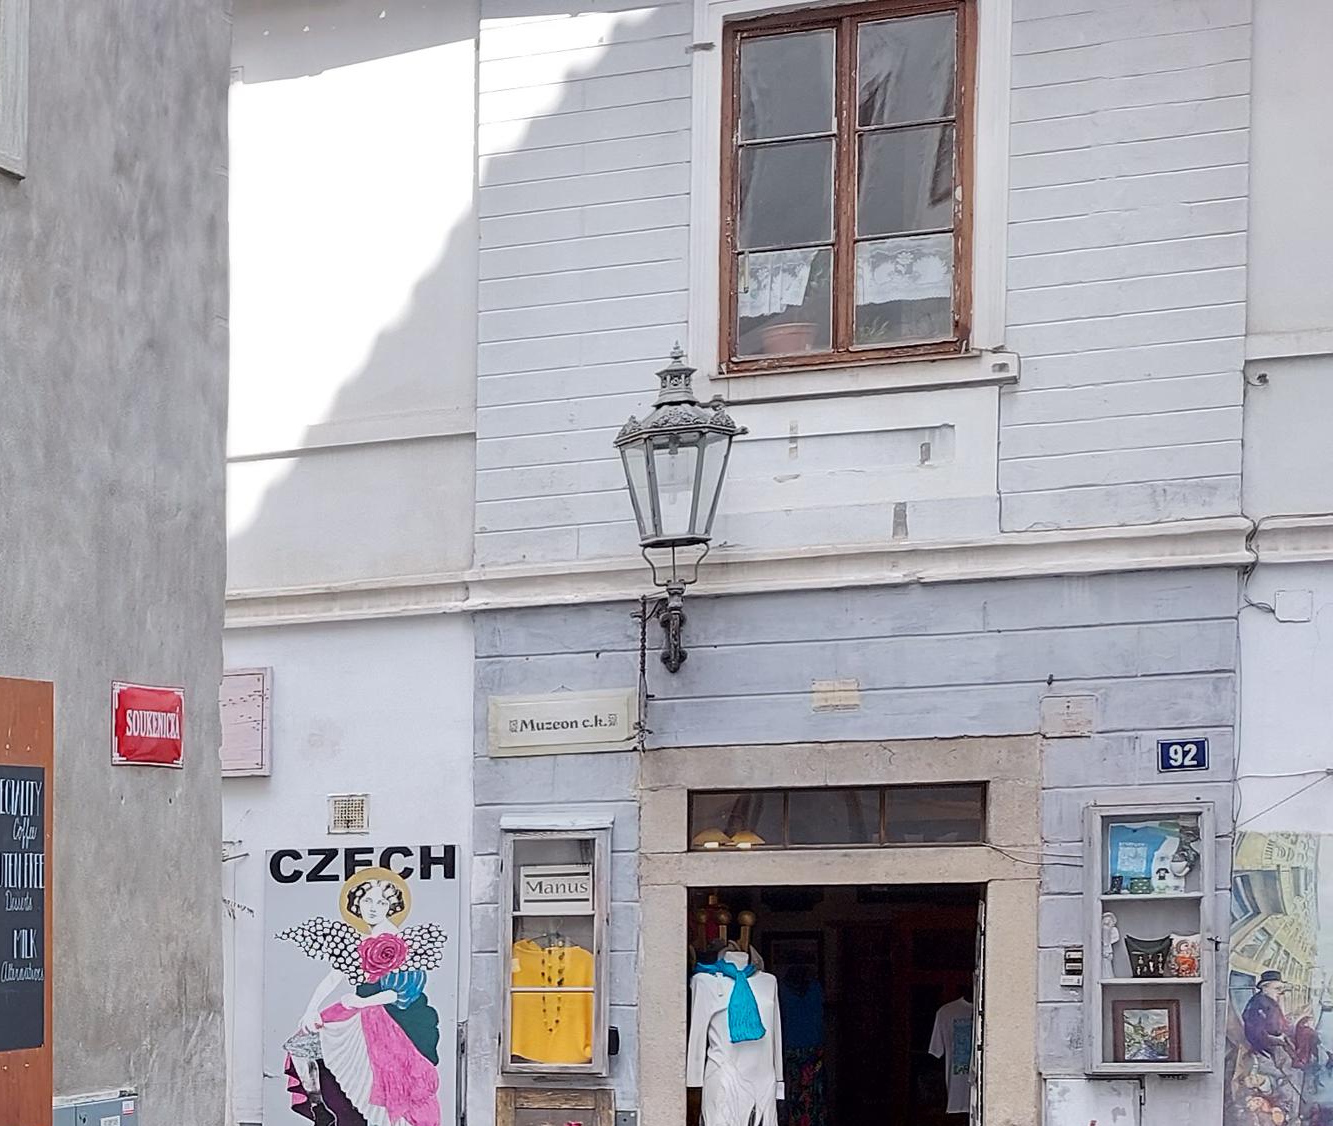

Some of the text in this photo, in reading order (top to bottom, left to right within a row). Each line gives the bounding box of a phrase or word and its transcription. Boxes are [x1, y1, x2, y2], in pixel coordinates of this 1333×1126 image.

[125, 706, 181, 740] SOUKENICKÁ
[519, 719, 579, 732] Muzeon
[1169, 743, 1198, 767] 92
[23, 853, 45, 889] FREE
[269, 845, 457, 884] CZECH
[525, 880, 588, 895] Manus
[13, 928, 38, 959] MILK
